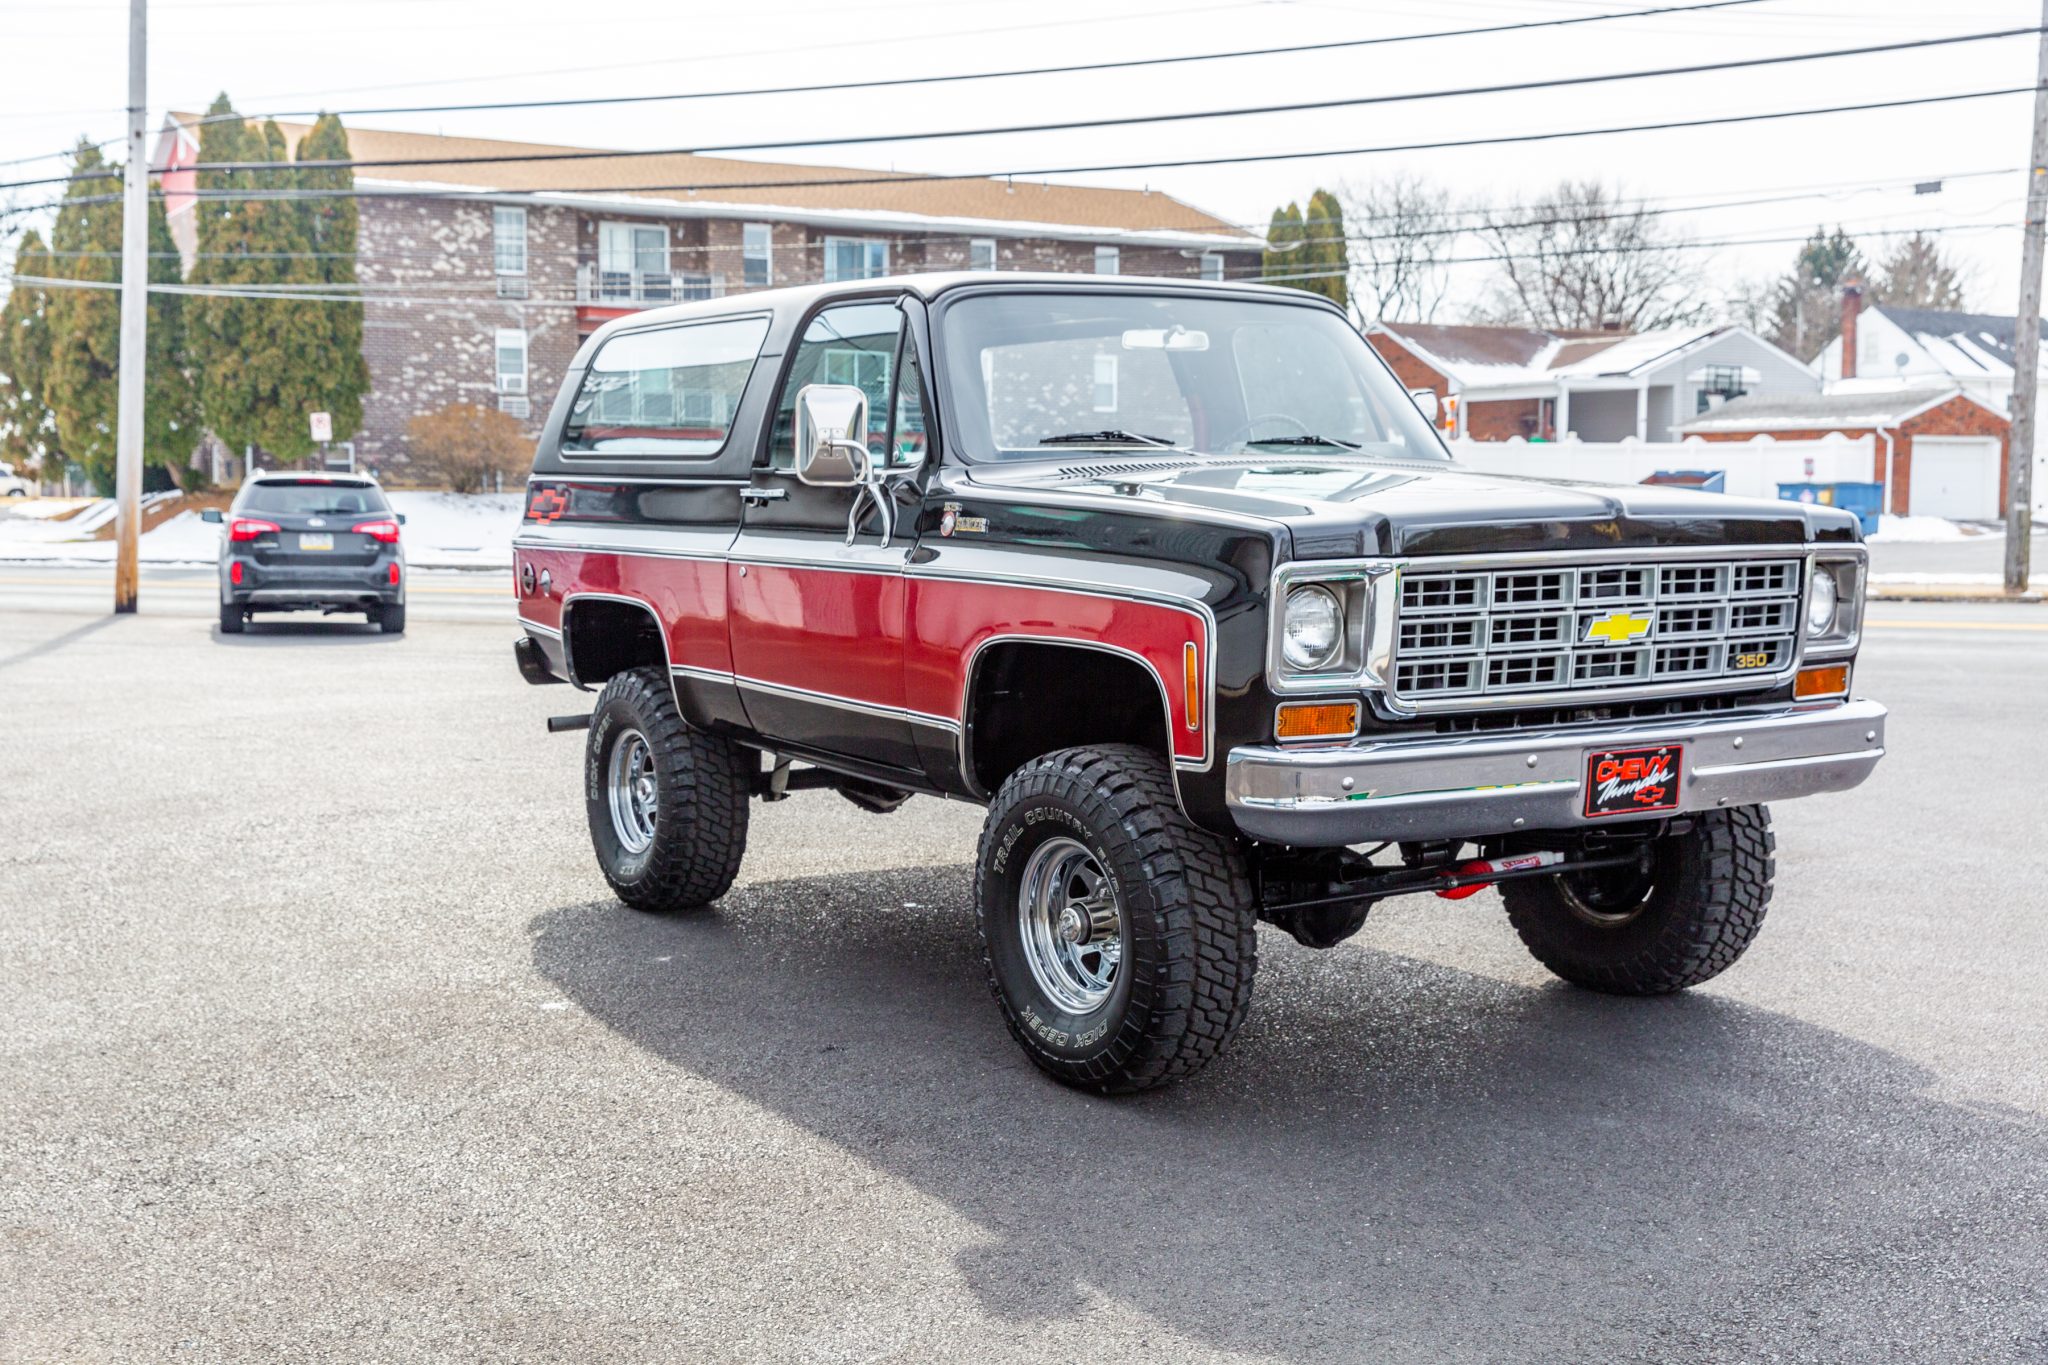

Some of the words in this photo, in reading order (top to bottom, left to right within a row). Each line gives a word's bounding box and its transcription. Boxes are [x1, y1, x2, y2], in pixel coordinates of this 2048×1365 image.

[1735, 652, 1768, 669] 350
[1596, 754, 1672, 782] CHEVY
[1597, 764, 1675, 805] Thunder
[993, 824, 1024, 875] TRAIL
[1024, 806, 1094, 841] COUNTRY
[1020, 1005, 1070, 1047] CEPEK
[1074, 1018, 1108, 1048] DICK
